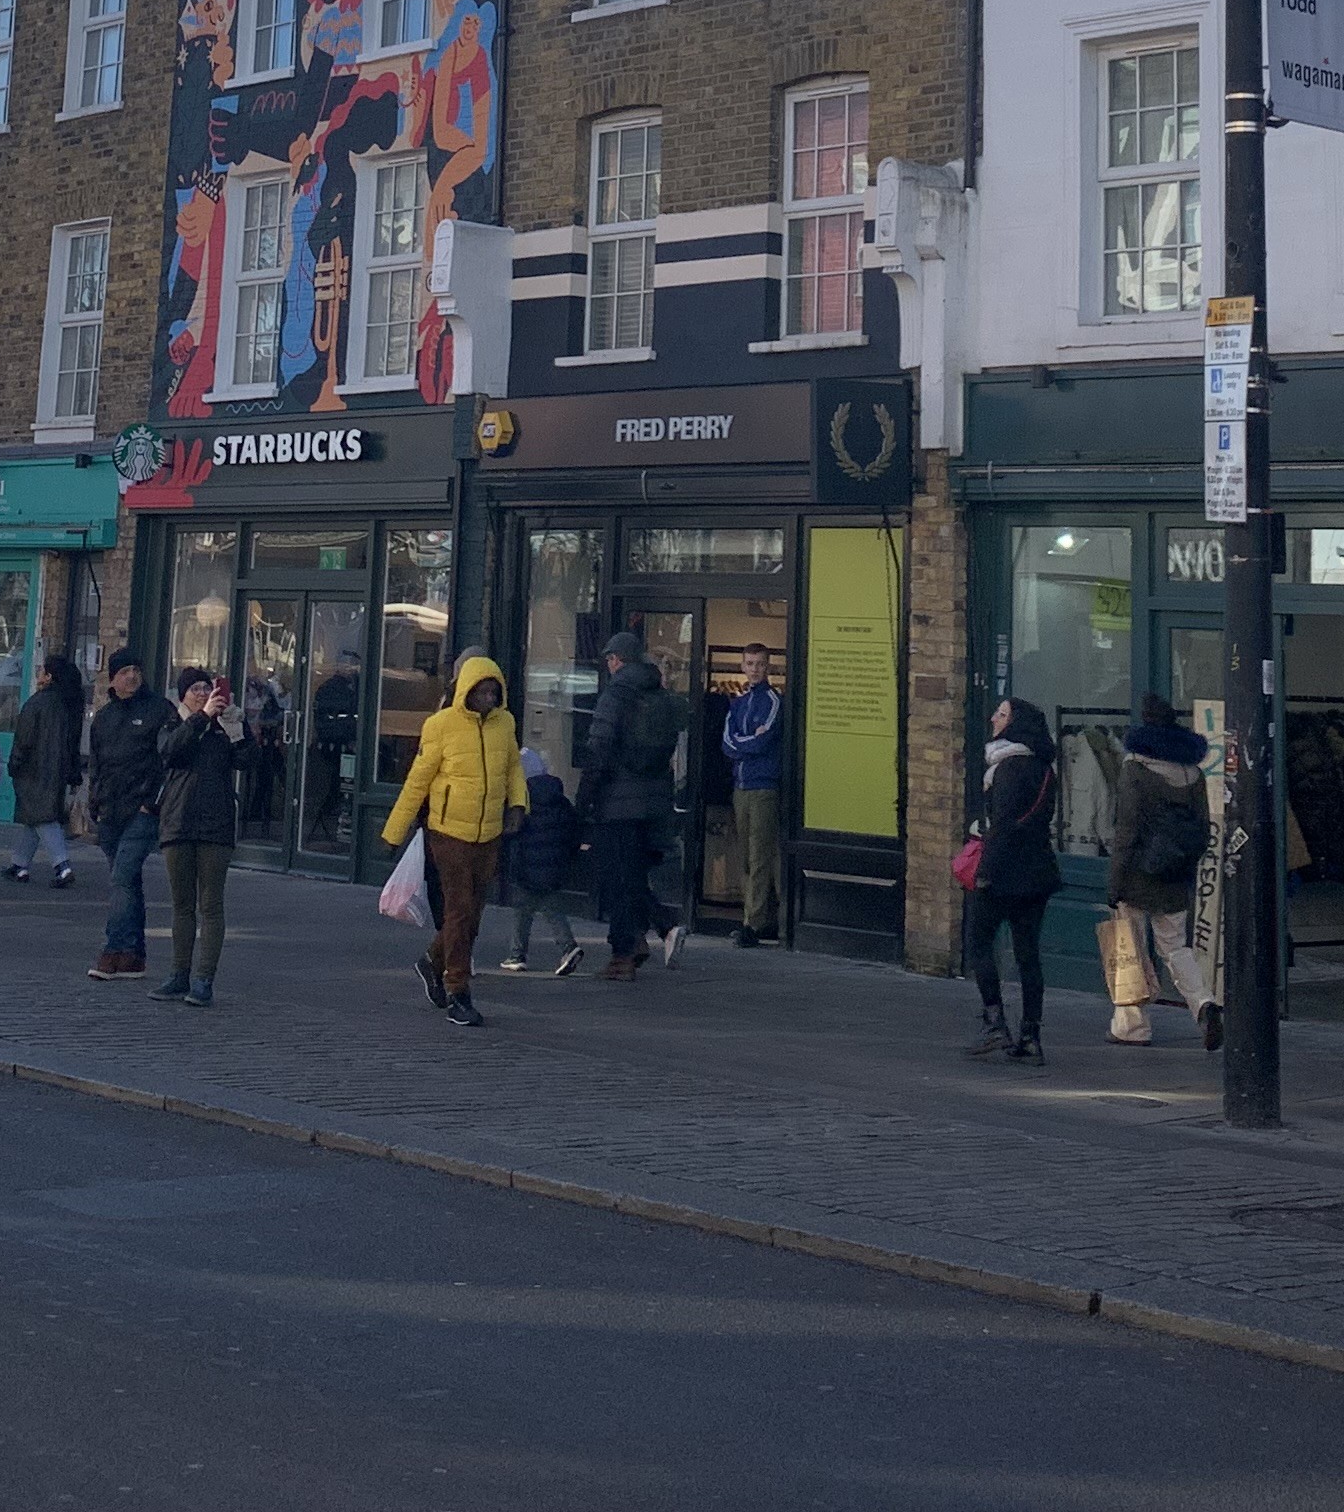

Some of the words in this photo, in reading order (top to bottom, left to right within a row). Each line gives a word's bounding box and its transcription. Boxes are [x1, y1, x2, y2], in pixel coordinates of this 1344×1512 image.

[616, 417, 665, 442] FRED
[668, 414, 734, 440] PERRY
[213, 428, 363, 466] STARBUCKS
